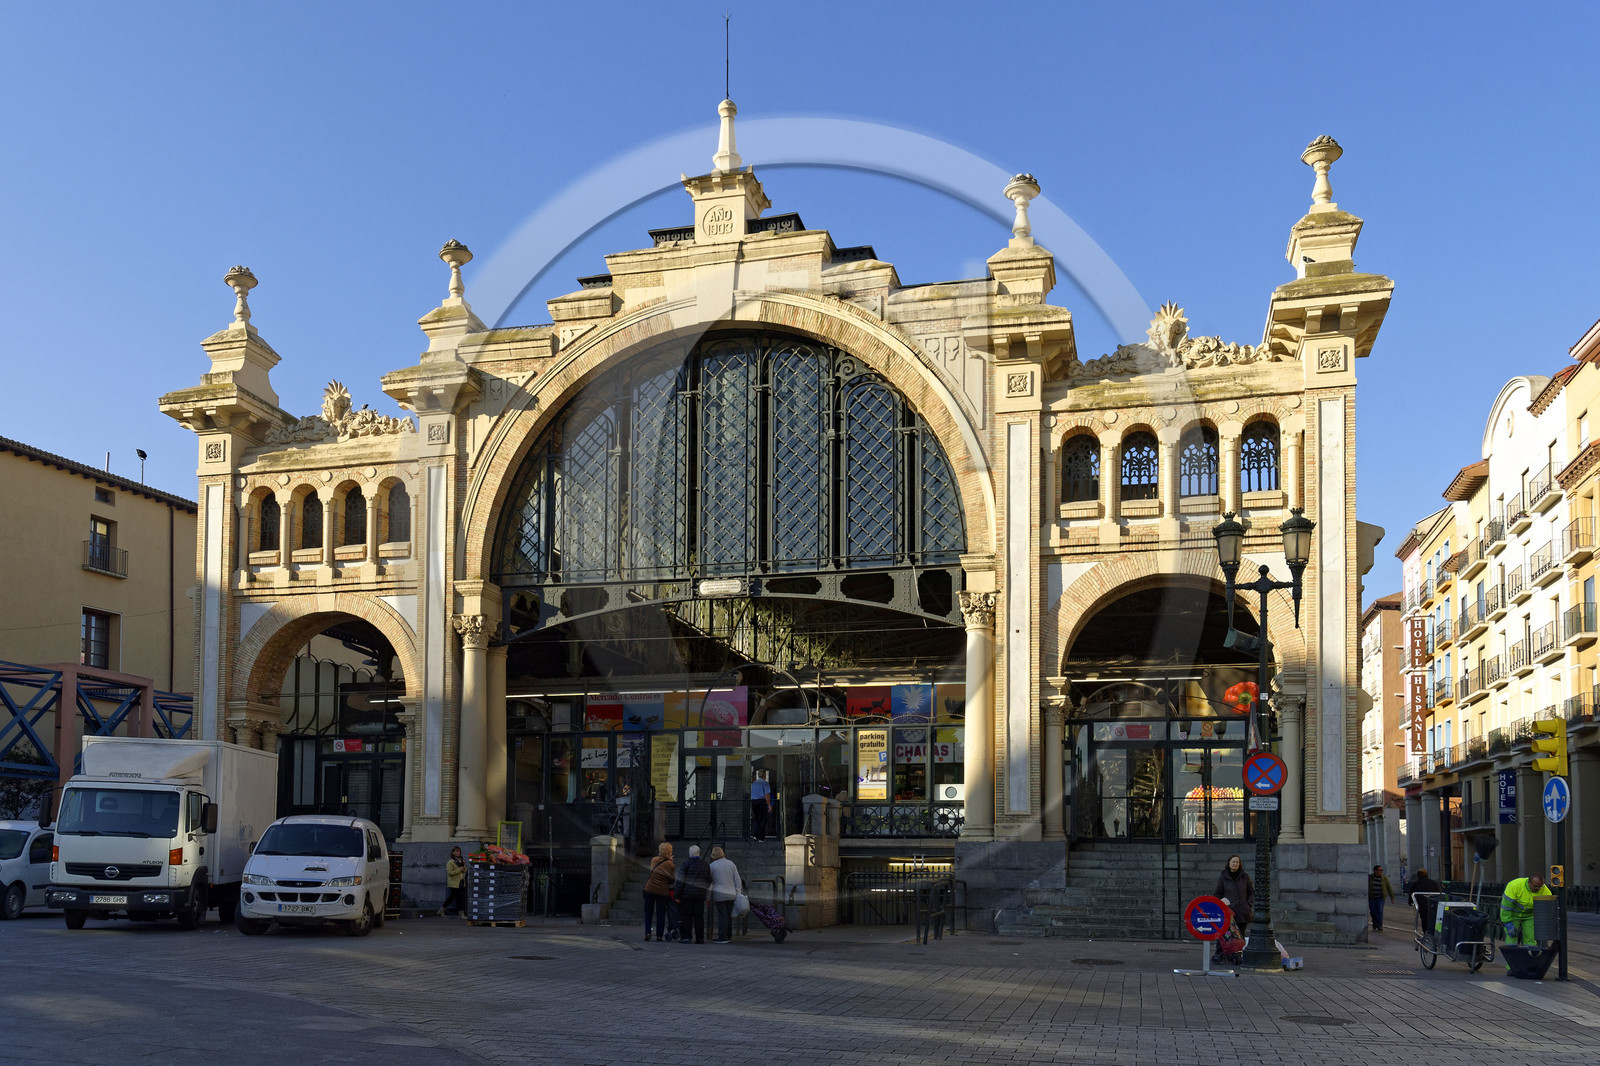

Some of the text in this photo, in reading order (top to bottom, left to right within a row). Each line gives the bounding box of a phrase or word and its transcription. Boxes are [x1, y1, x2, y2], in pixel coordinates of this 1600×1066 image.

[709, 208, 733, 222] AÑO
[708, 223, 734, 236] 1903
[1414, 620, 1423, 751] HOTEL HISPANIA
[860, 733, 885, 741] parking
[860, 741, 885, 749] gratuito
[895, 744, 950, 758] CHAAS
[1499, 773, 1507, 808] HOTEL
